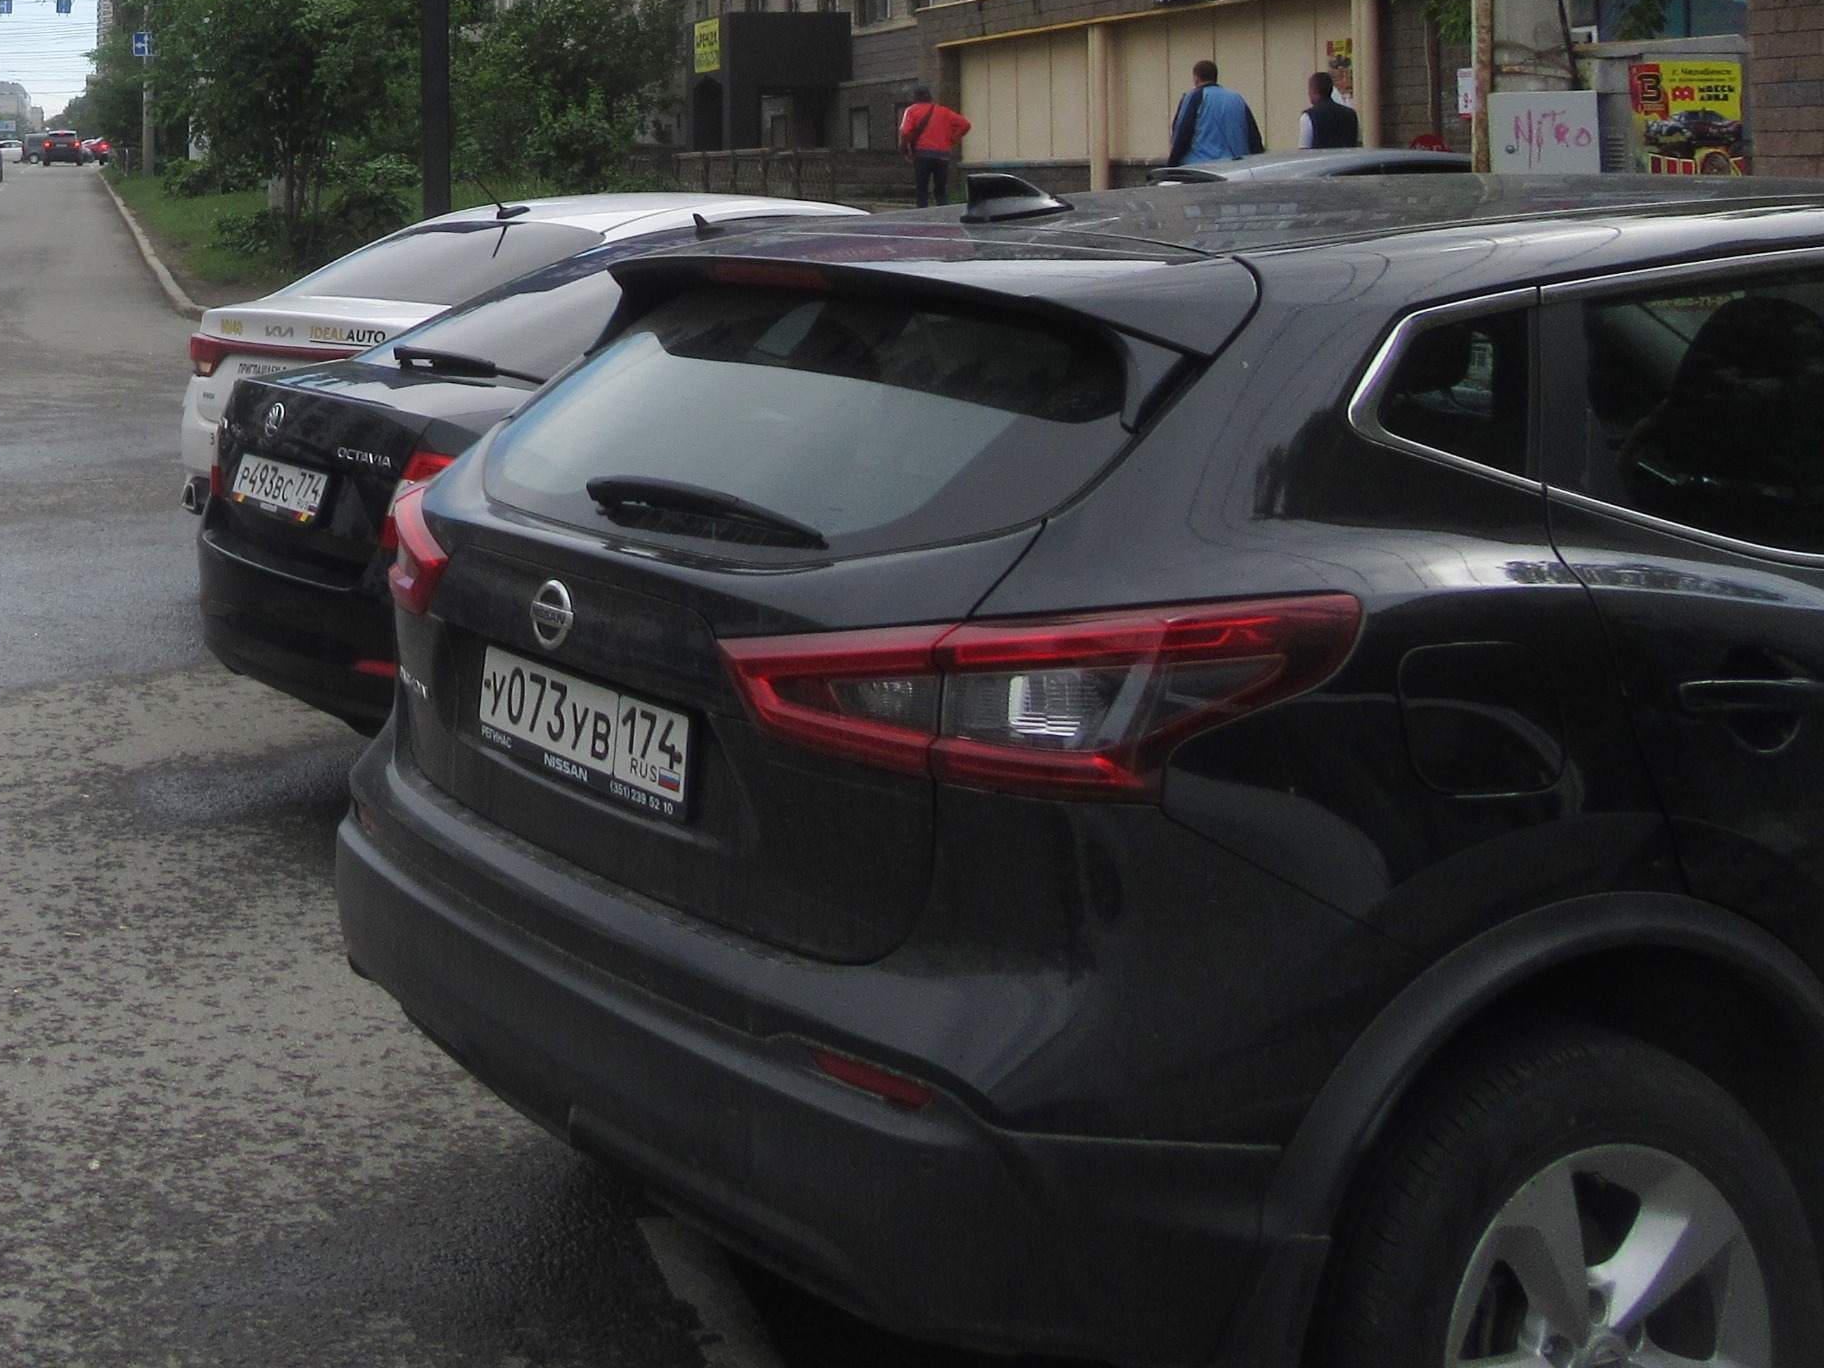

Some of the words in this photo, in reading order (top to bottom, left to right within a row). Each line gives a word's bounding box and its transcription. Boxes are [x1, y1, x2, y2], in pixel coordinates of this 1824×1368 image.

[337, 447, 391, 468] OCTAVIA
[622, 705, 676, 770] 174
[544, 752, 588, 782] NISSAN
[629, 756, 658, 783] RUS
